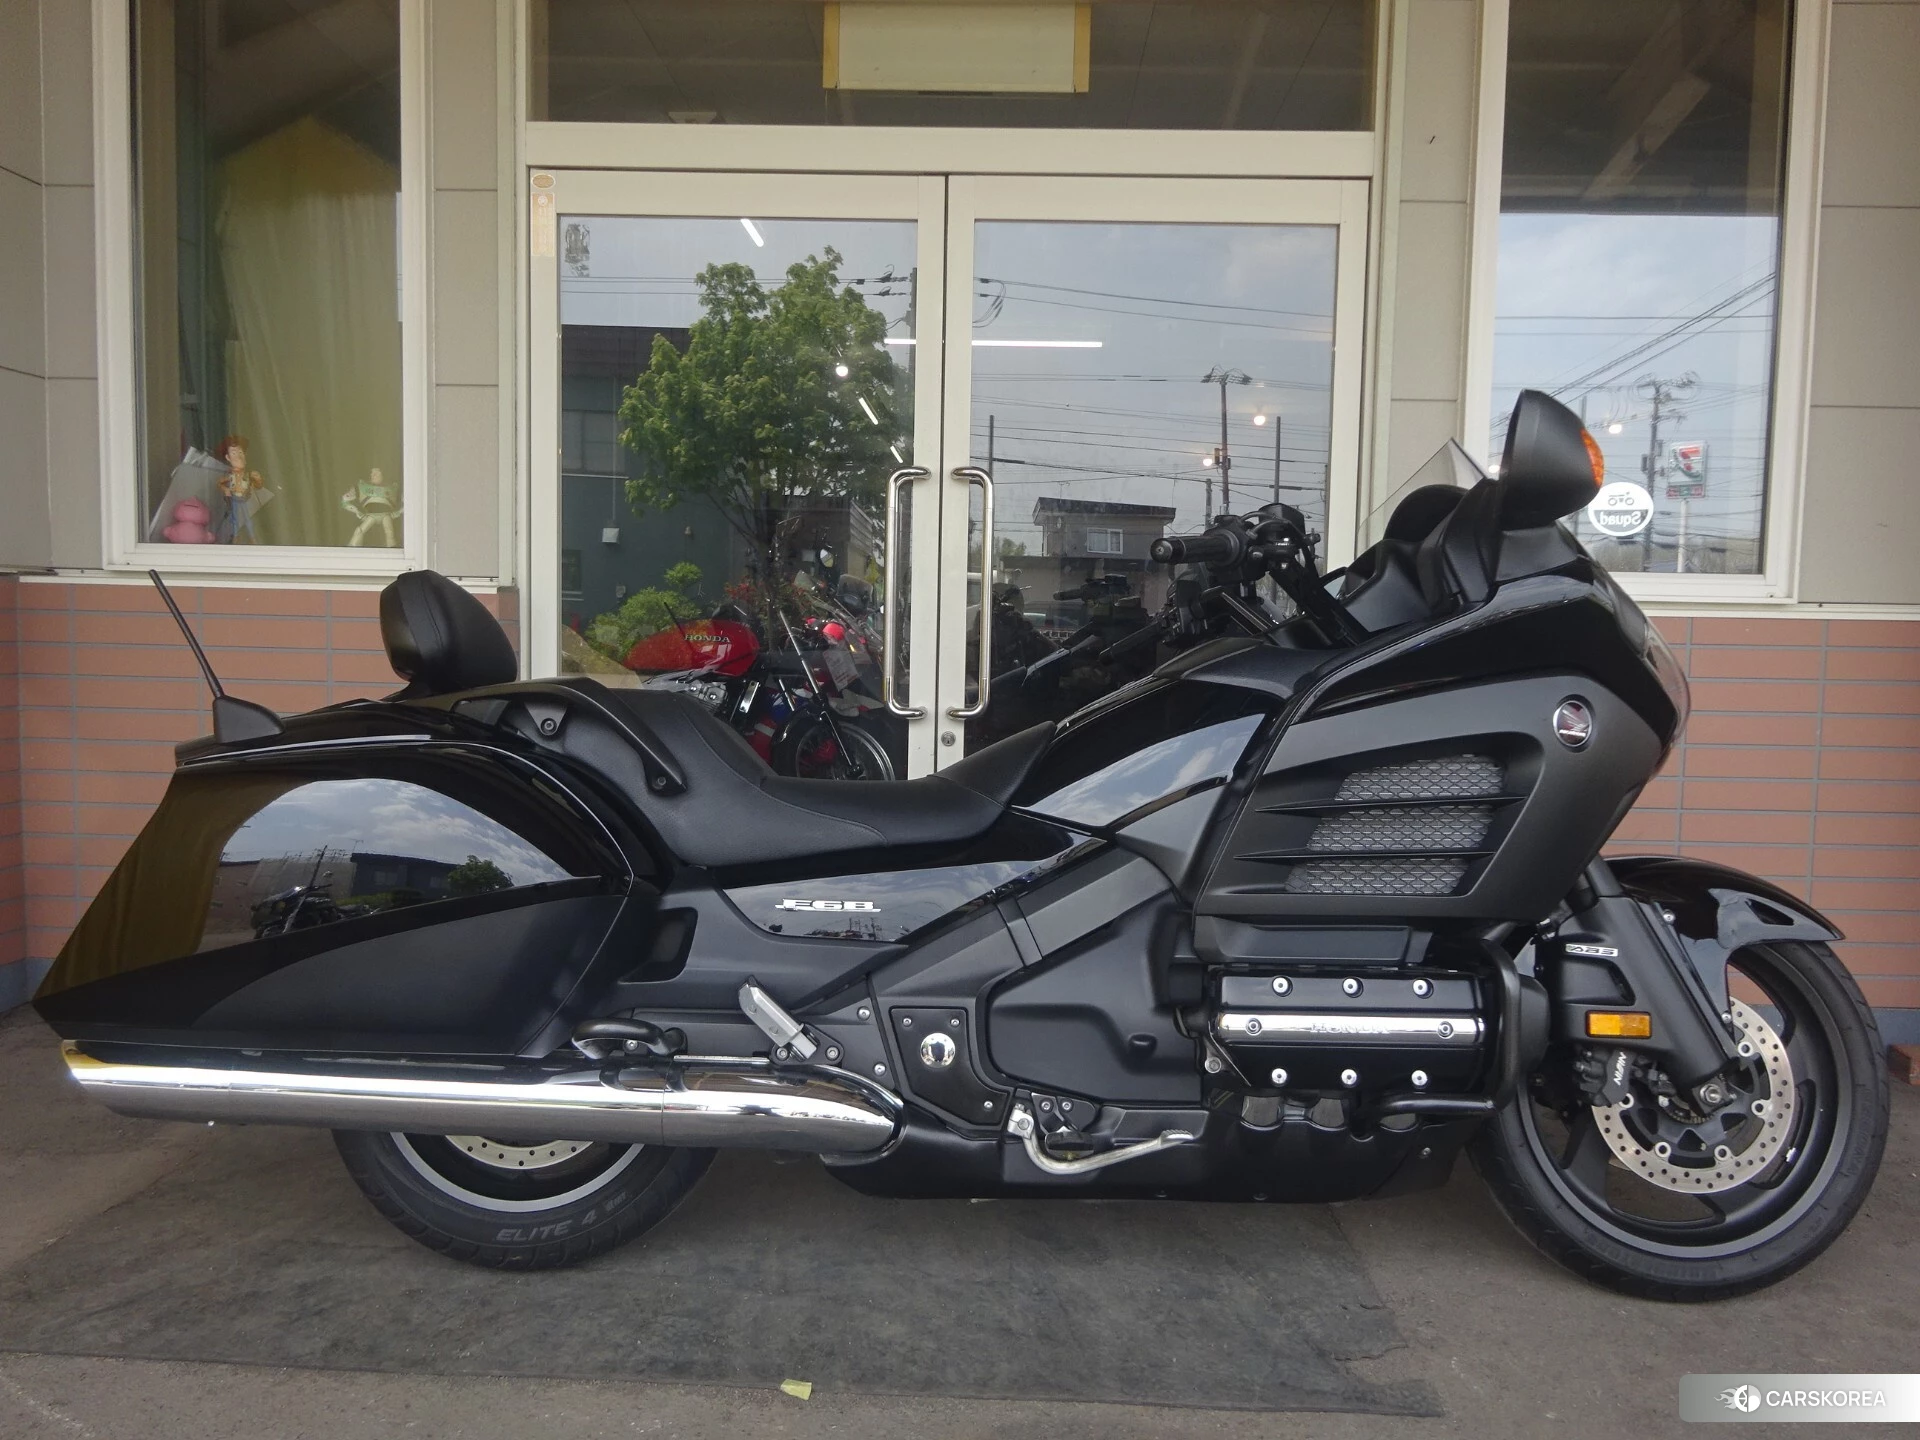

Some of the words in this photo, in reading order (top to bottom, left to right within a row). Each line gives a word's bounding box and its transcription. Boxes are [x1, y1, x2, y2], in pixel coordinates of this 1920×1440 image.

[684, 634, 731, 643] HONDA
[782, 899, 875, 912] F6B
[1569, 945, 1616, 956] ABS
[495, 1219, 573, 1242] ELITE
[581, 1208, 598, 1226] 4
